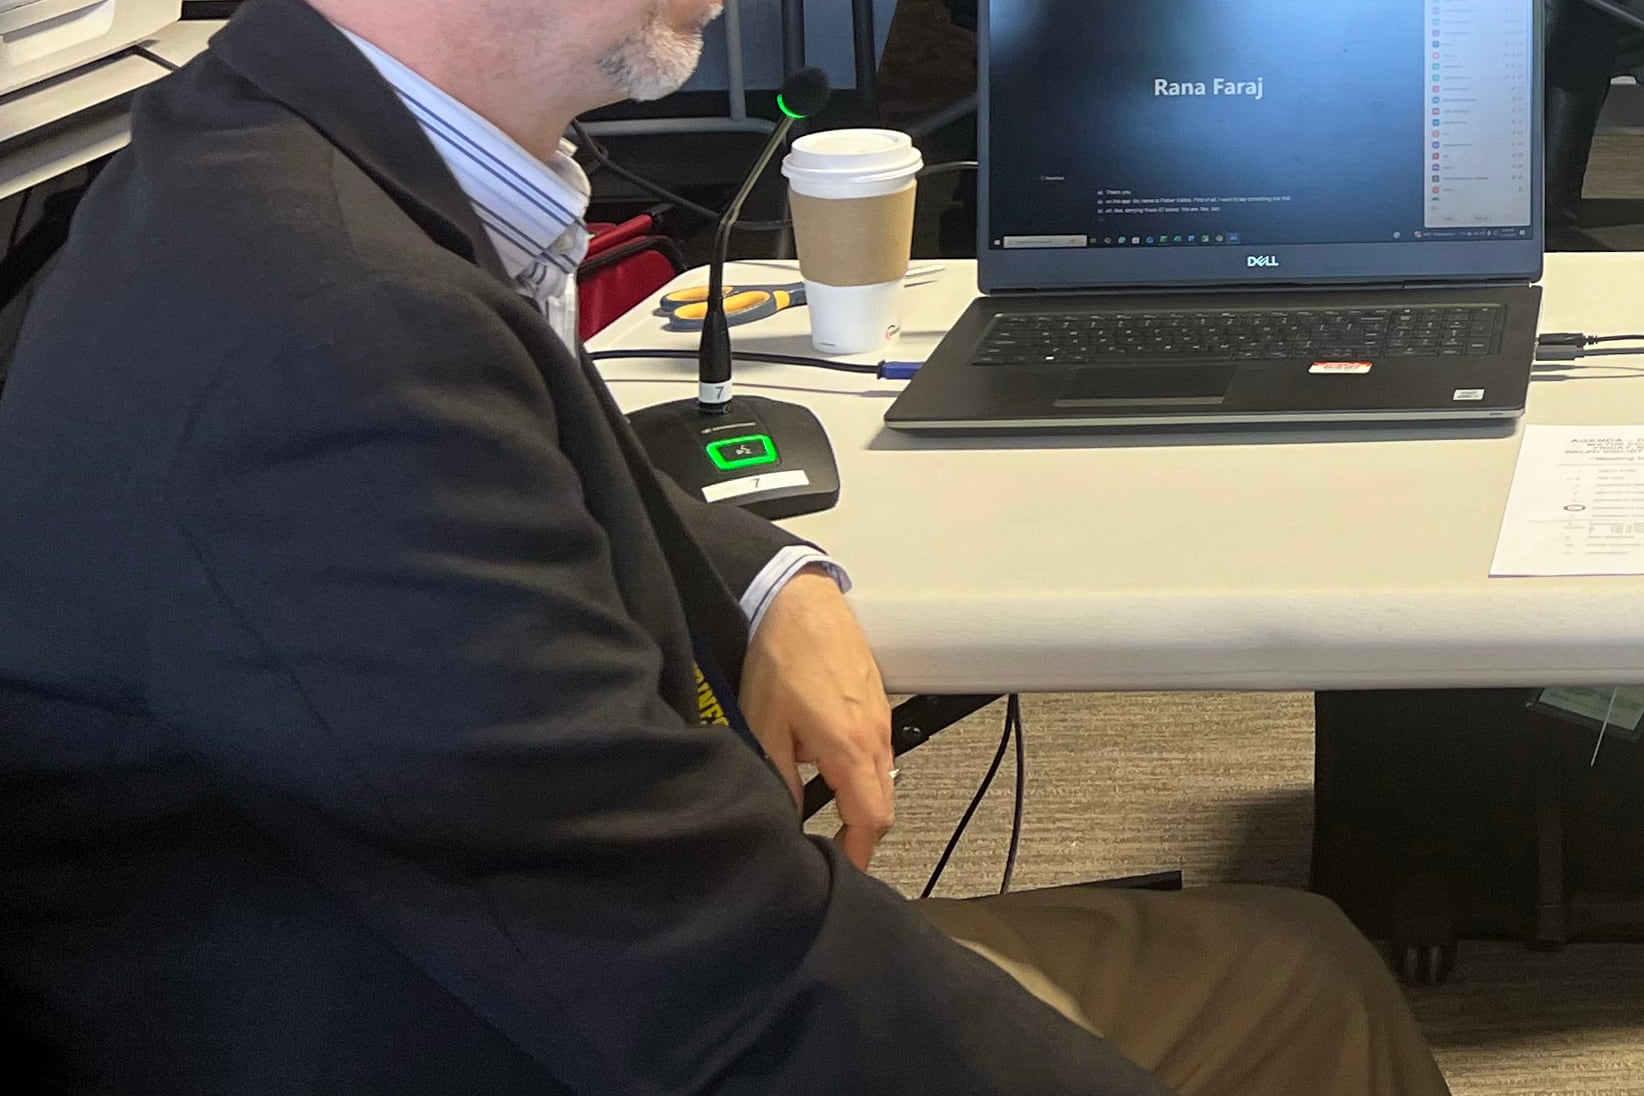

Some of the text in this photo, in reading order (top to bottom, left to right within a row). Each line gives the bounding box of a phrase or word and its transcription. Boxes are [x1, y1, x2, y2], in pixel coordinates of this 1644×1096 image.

[1154, 77, 1264, 99] Rana Faraj
[1247, 255, 1280, 267] DELL
[715, 386, 725, 399] 7
[751, 478, 760, 489] 7
